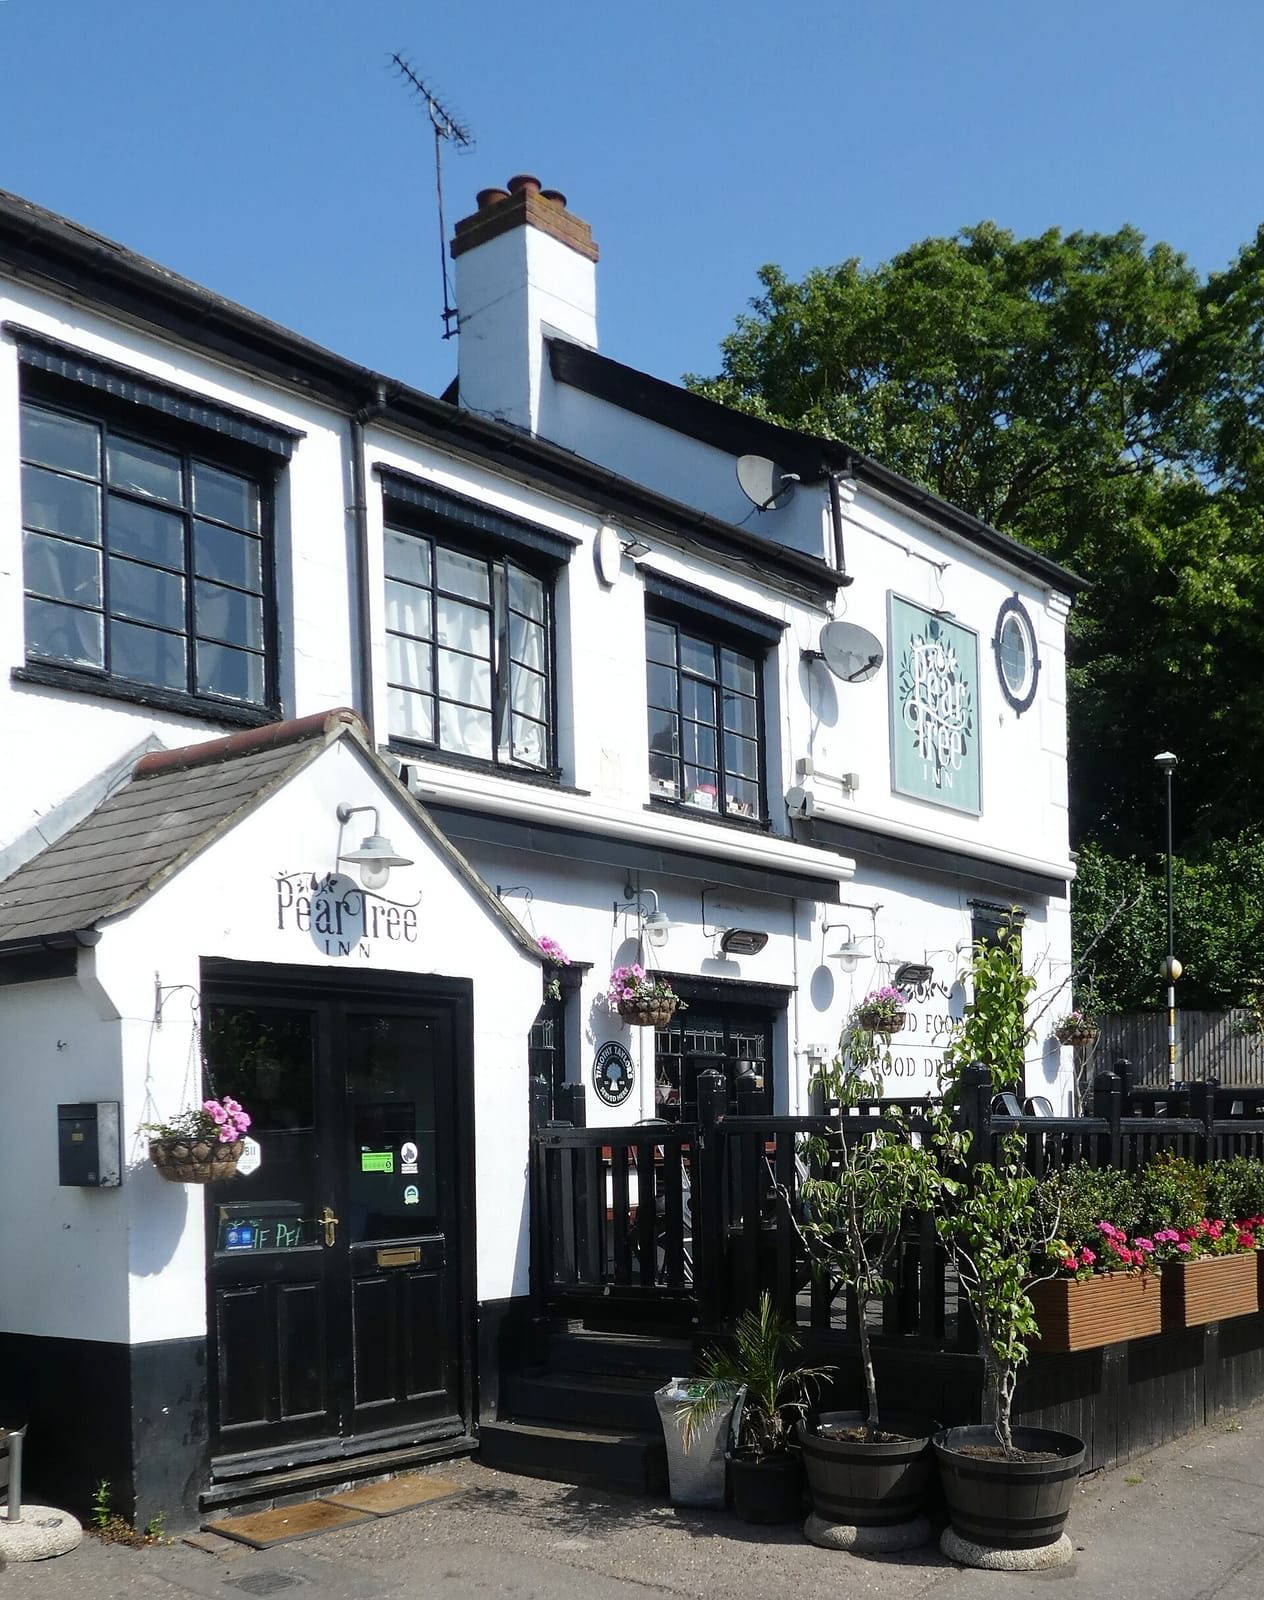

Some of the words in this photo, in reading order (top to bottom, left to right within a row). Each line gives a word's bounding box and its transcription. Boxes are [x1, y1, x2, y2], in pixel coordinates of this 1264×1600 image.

[910, 642, 966, 720] Pear
[904, 700, 965, 770] Tree
[923, 764, 953, 788] INN
[273, 872, 346, 935] Pear
[342, 888, 423, 943] Tree
[324, 940, 371, 959] INN
[595, 1046, 613, 1079] TIMOTHY
[873, 1056, 916, 1077] OOD
